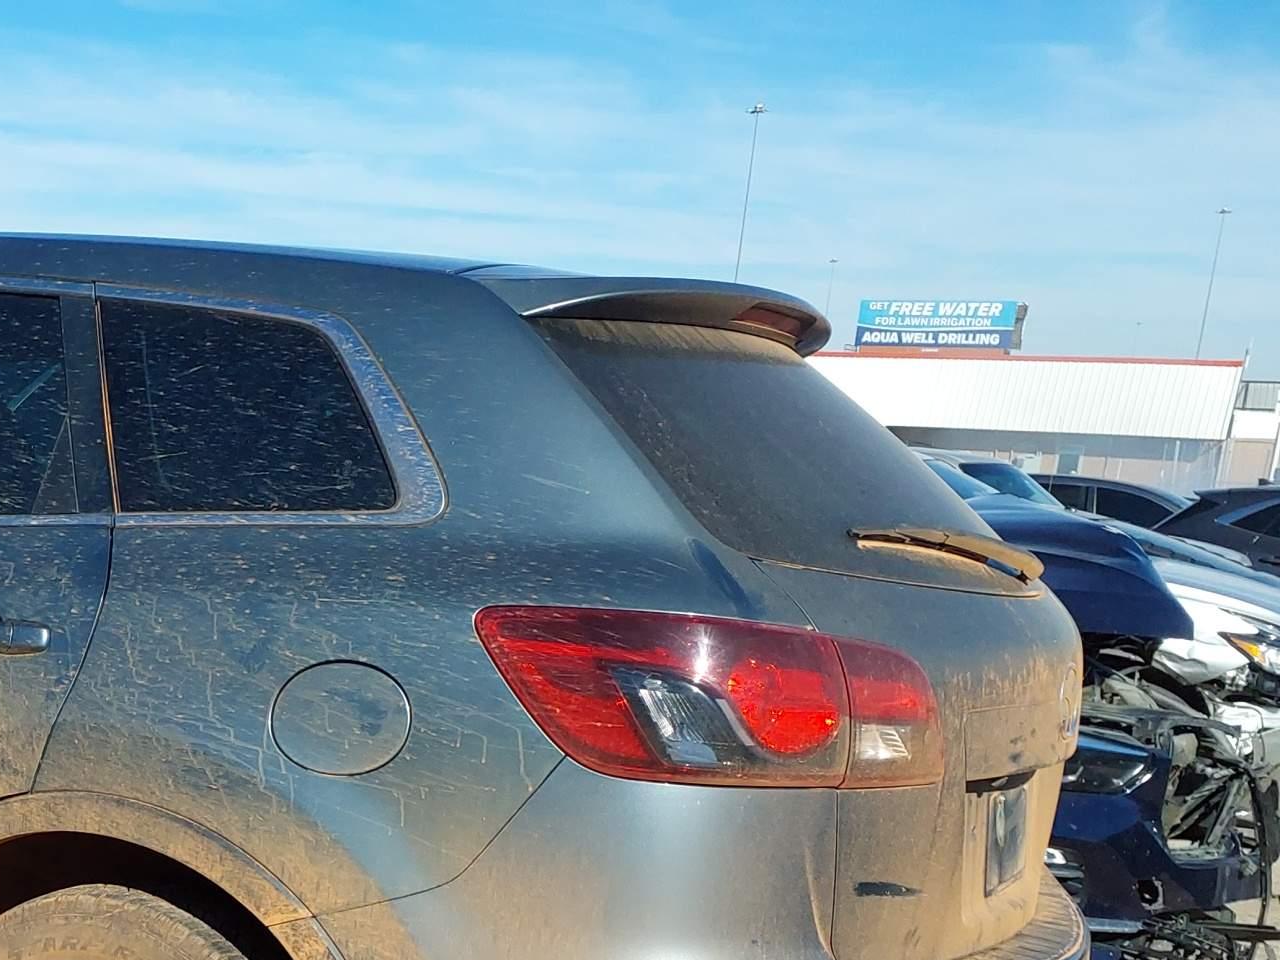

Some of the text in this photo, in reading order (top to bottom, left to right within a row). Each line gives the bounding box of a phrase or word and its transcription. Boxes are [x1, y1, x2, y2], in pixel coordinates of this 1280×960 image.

[870, 302, 1003, 317] GET FREE WATER
[875, 316, 992, 327] FOR LAWN IRRIGATION
[862, 331, 1000, 345] AQUA WELL DRILLING
